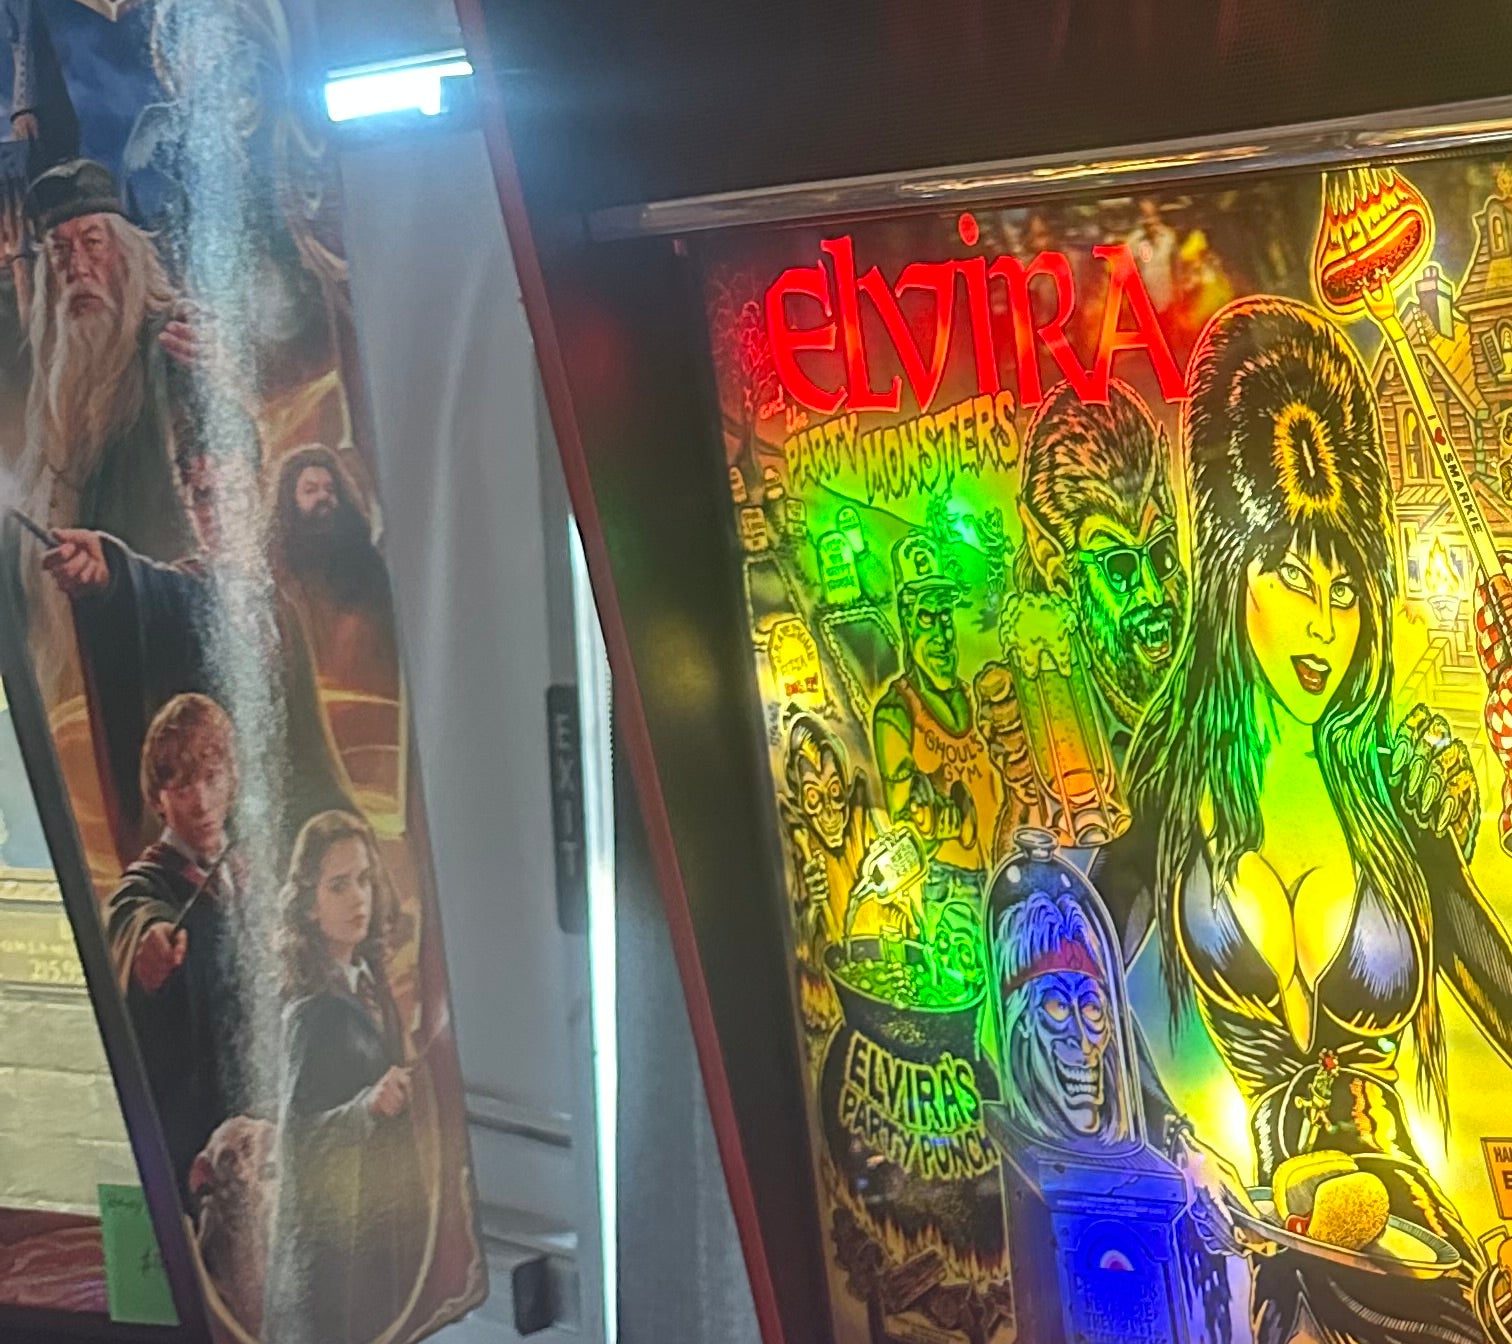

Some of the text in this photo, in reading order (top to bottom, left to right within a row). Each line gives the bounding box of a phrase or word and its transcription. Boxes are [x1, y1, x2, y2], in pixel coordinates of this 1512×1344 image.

[784, 389, 1020, 505] PARTY MONSTERS
[1443, 452, 1484, 534] SMARKIE
[924, 728, 985, 764] GHOUL'S
[942, 762, 983, 783] GYM
[846, 1030, 984, 1133] ELVIRA'S
[839, 1081, 1002, 1181] PARTY PUNCH
